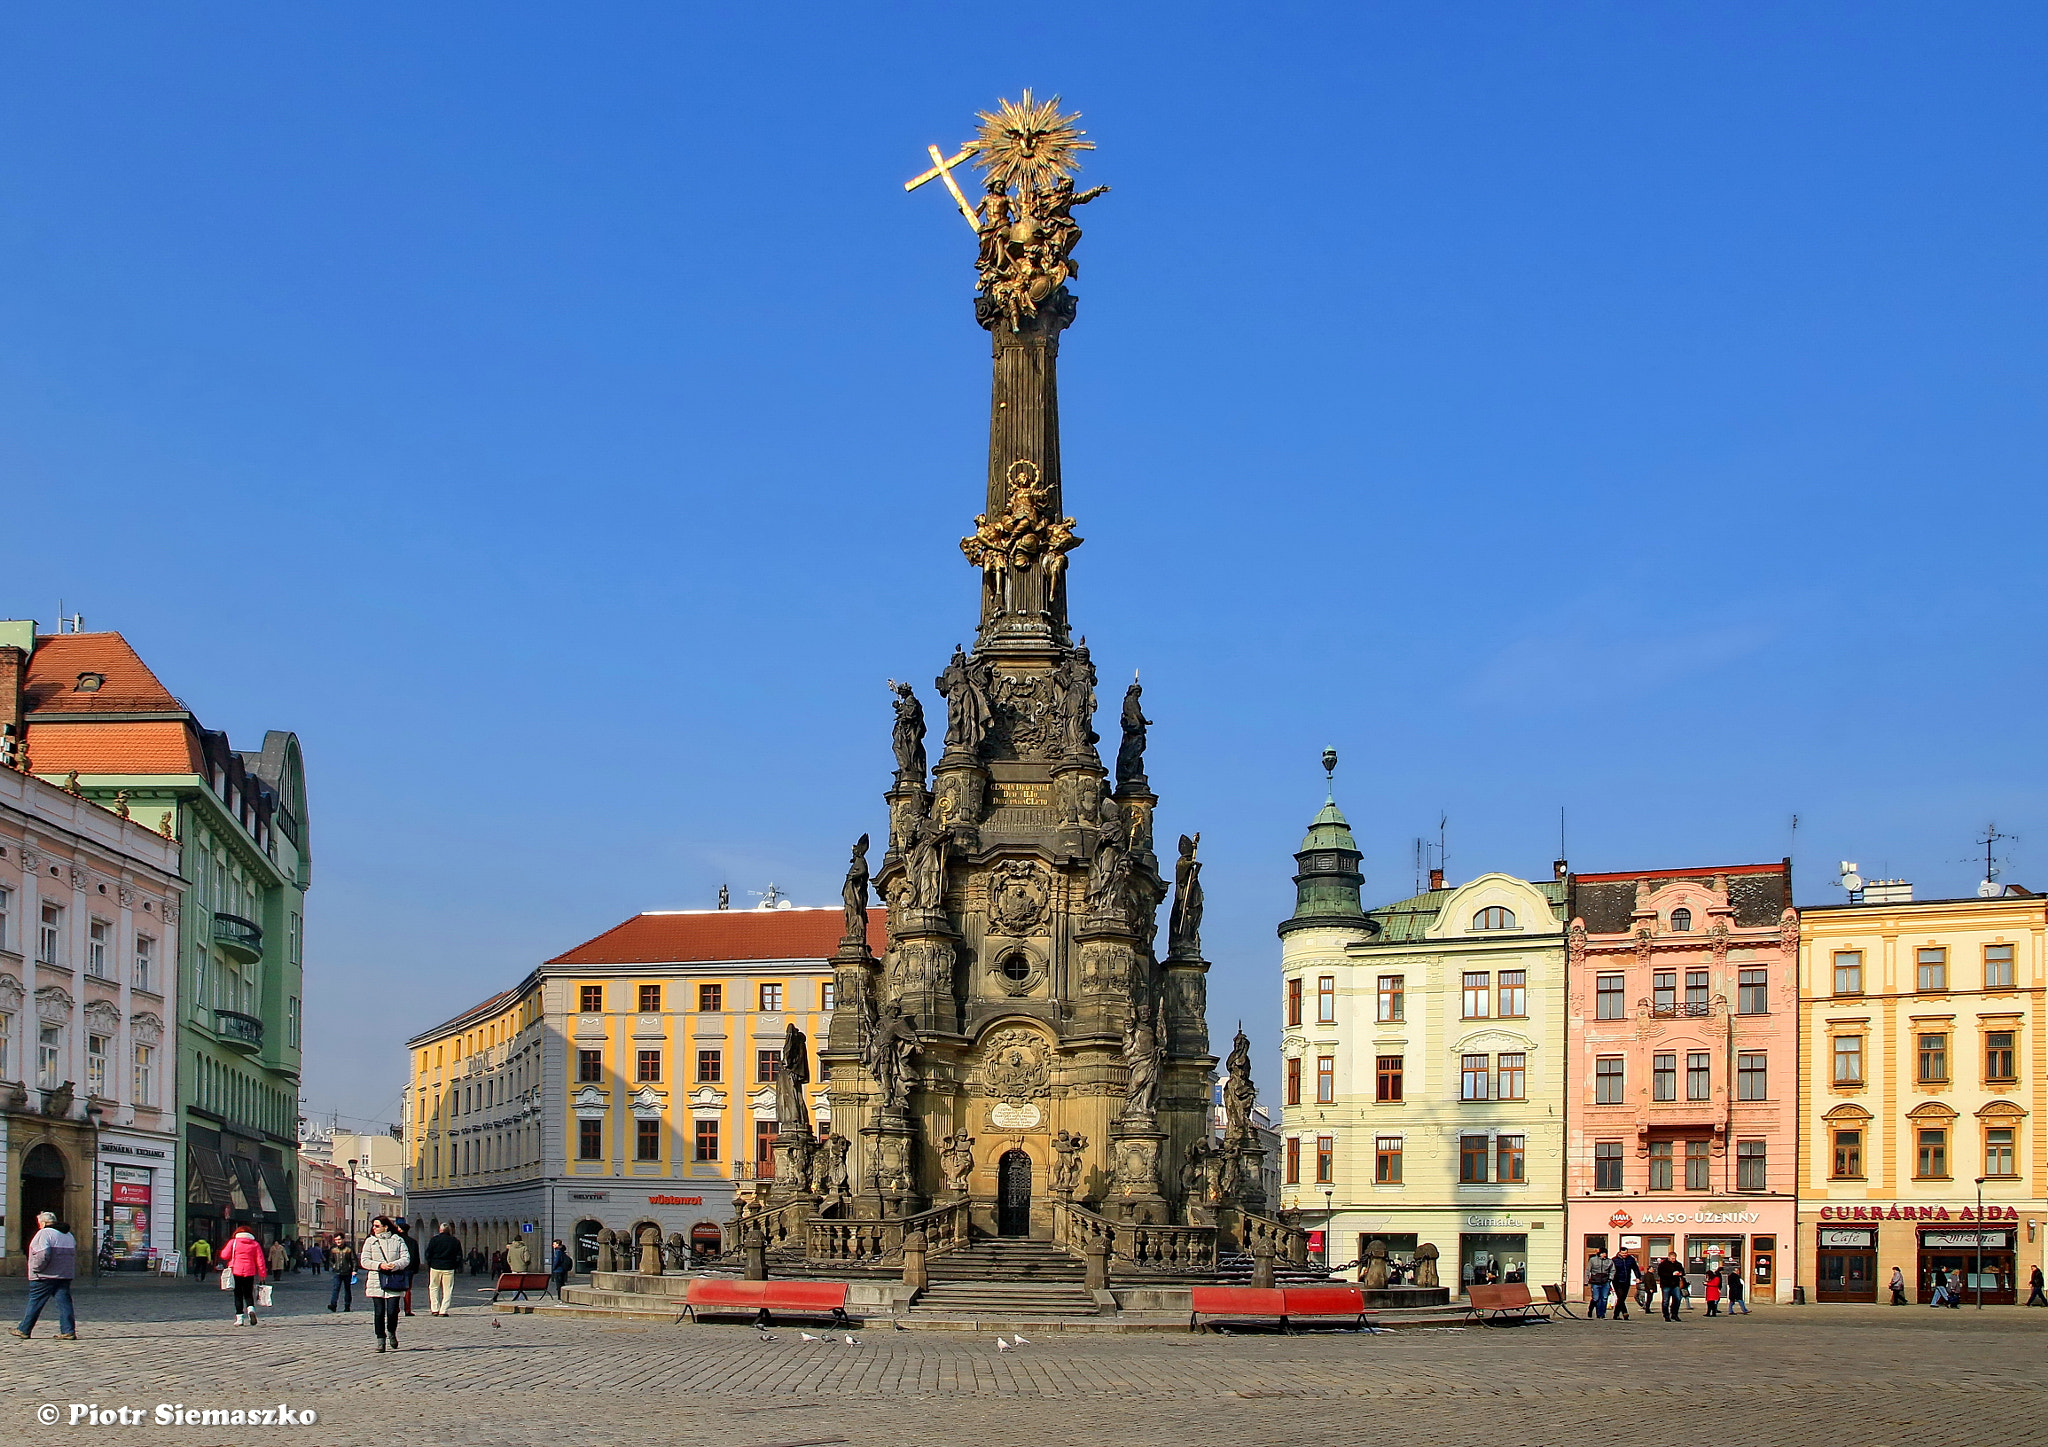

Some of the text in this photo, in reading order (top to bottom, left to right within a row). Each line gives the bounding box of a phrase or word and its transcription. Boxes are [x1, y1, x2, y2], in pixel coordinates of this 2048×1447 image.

[648, 1194, 703, 1205] wüstenrot
[1820, 1203, 2019, 1220] CUKRÁRNA AIDA
[1830, 1231, 1861, 1244] Café
